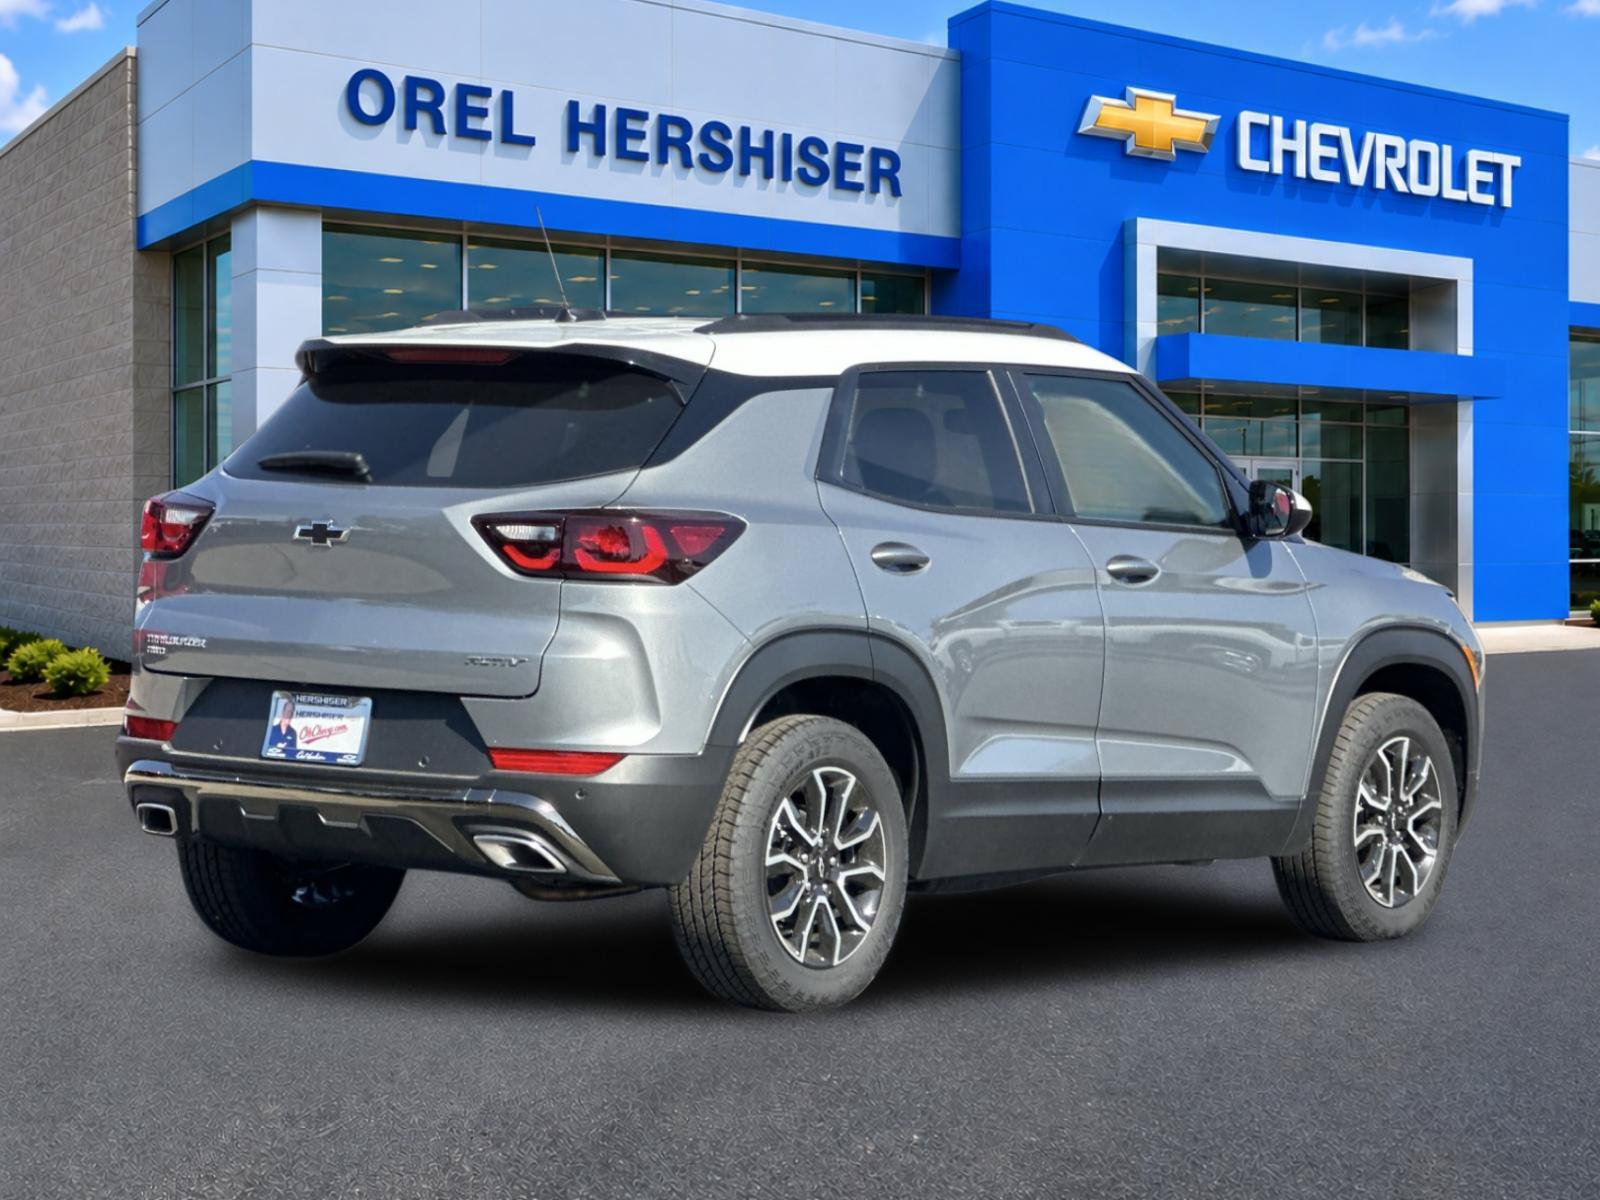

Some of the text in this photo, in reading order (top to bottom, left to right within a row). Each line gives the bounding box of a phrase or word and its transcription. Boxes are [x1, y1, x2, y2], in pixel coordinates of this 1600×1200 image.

[346, 68, 902, 197] OREL HERSHISER
[1237, 110, 1521, 208] CHEVROLET
